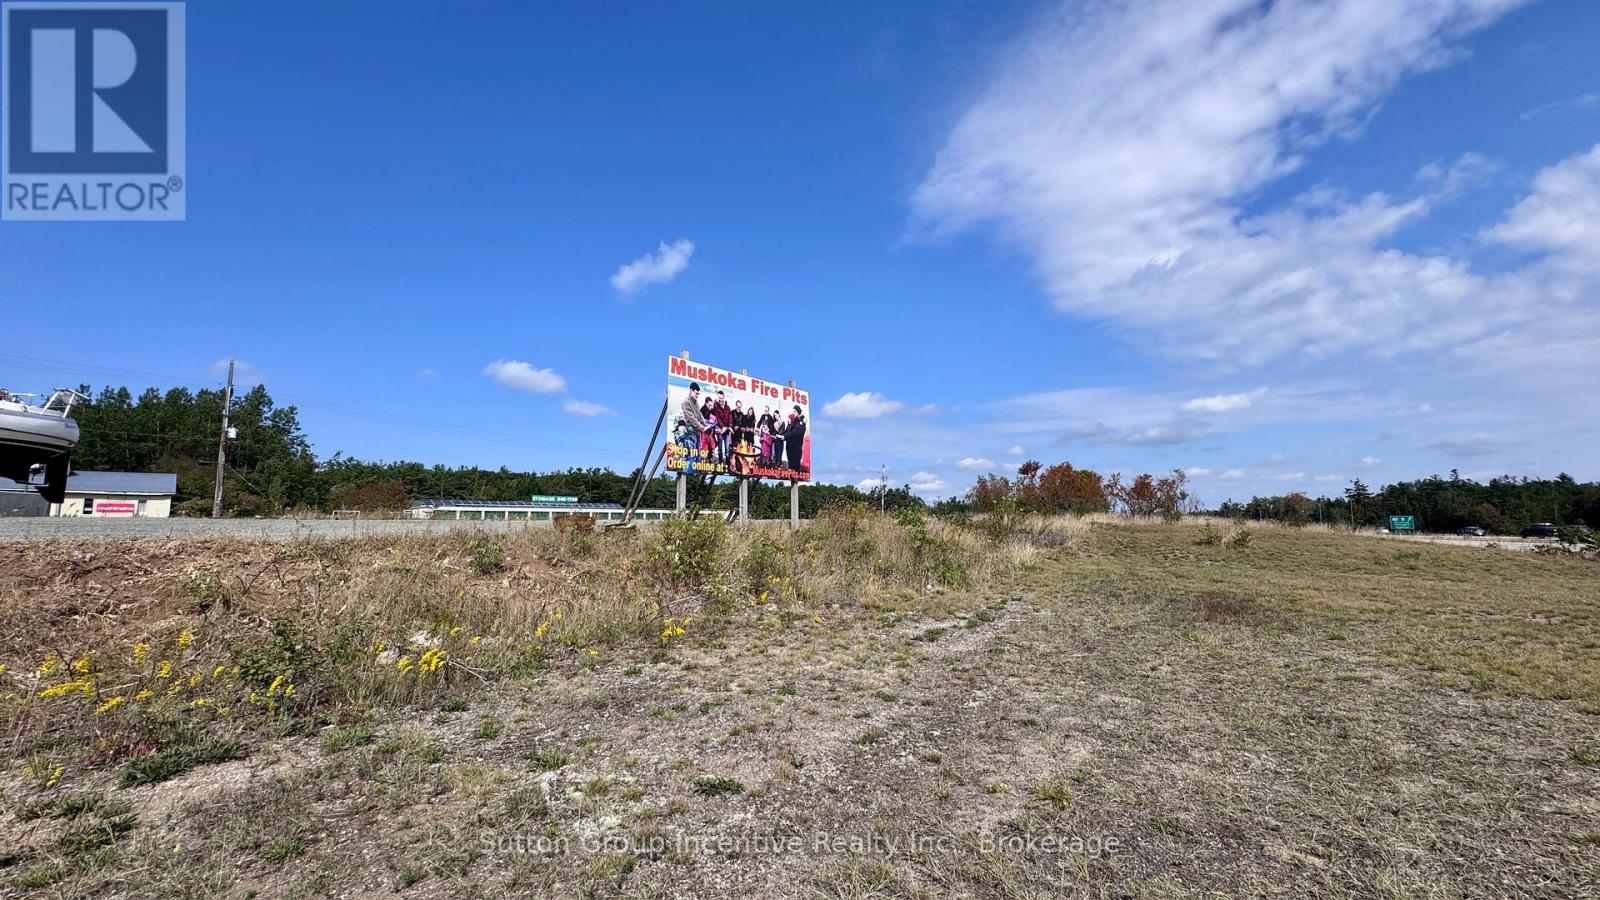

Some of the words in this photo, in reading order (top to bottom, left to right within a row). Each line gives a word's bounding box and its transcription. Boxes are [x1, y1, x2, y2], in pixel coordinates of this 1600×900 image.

[670, 357, 747, 391] Muskoka
[751, 378, 779, 399] Fire
[783, 386, 808, 406] Pits
[667, 443, 688, 457] Stop
[690, 448, 698, 457] in
[667, 457, 689, 469] Order
[692, 459, 715, 472] online
